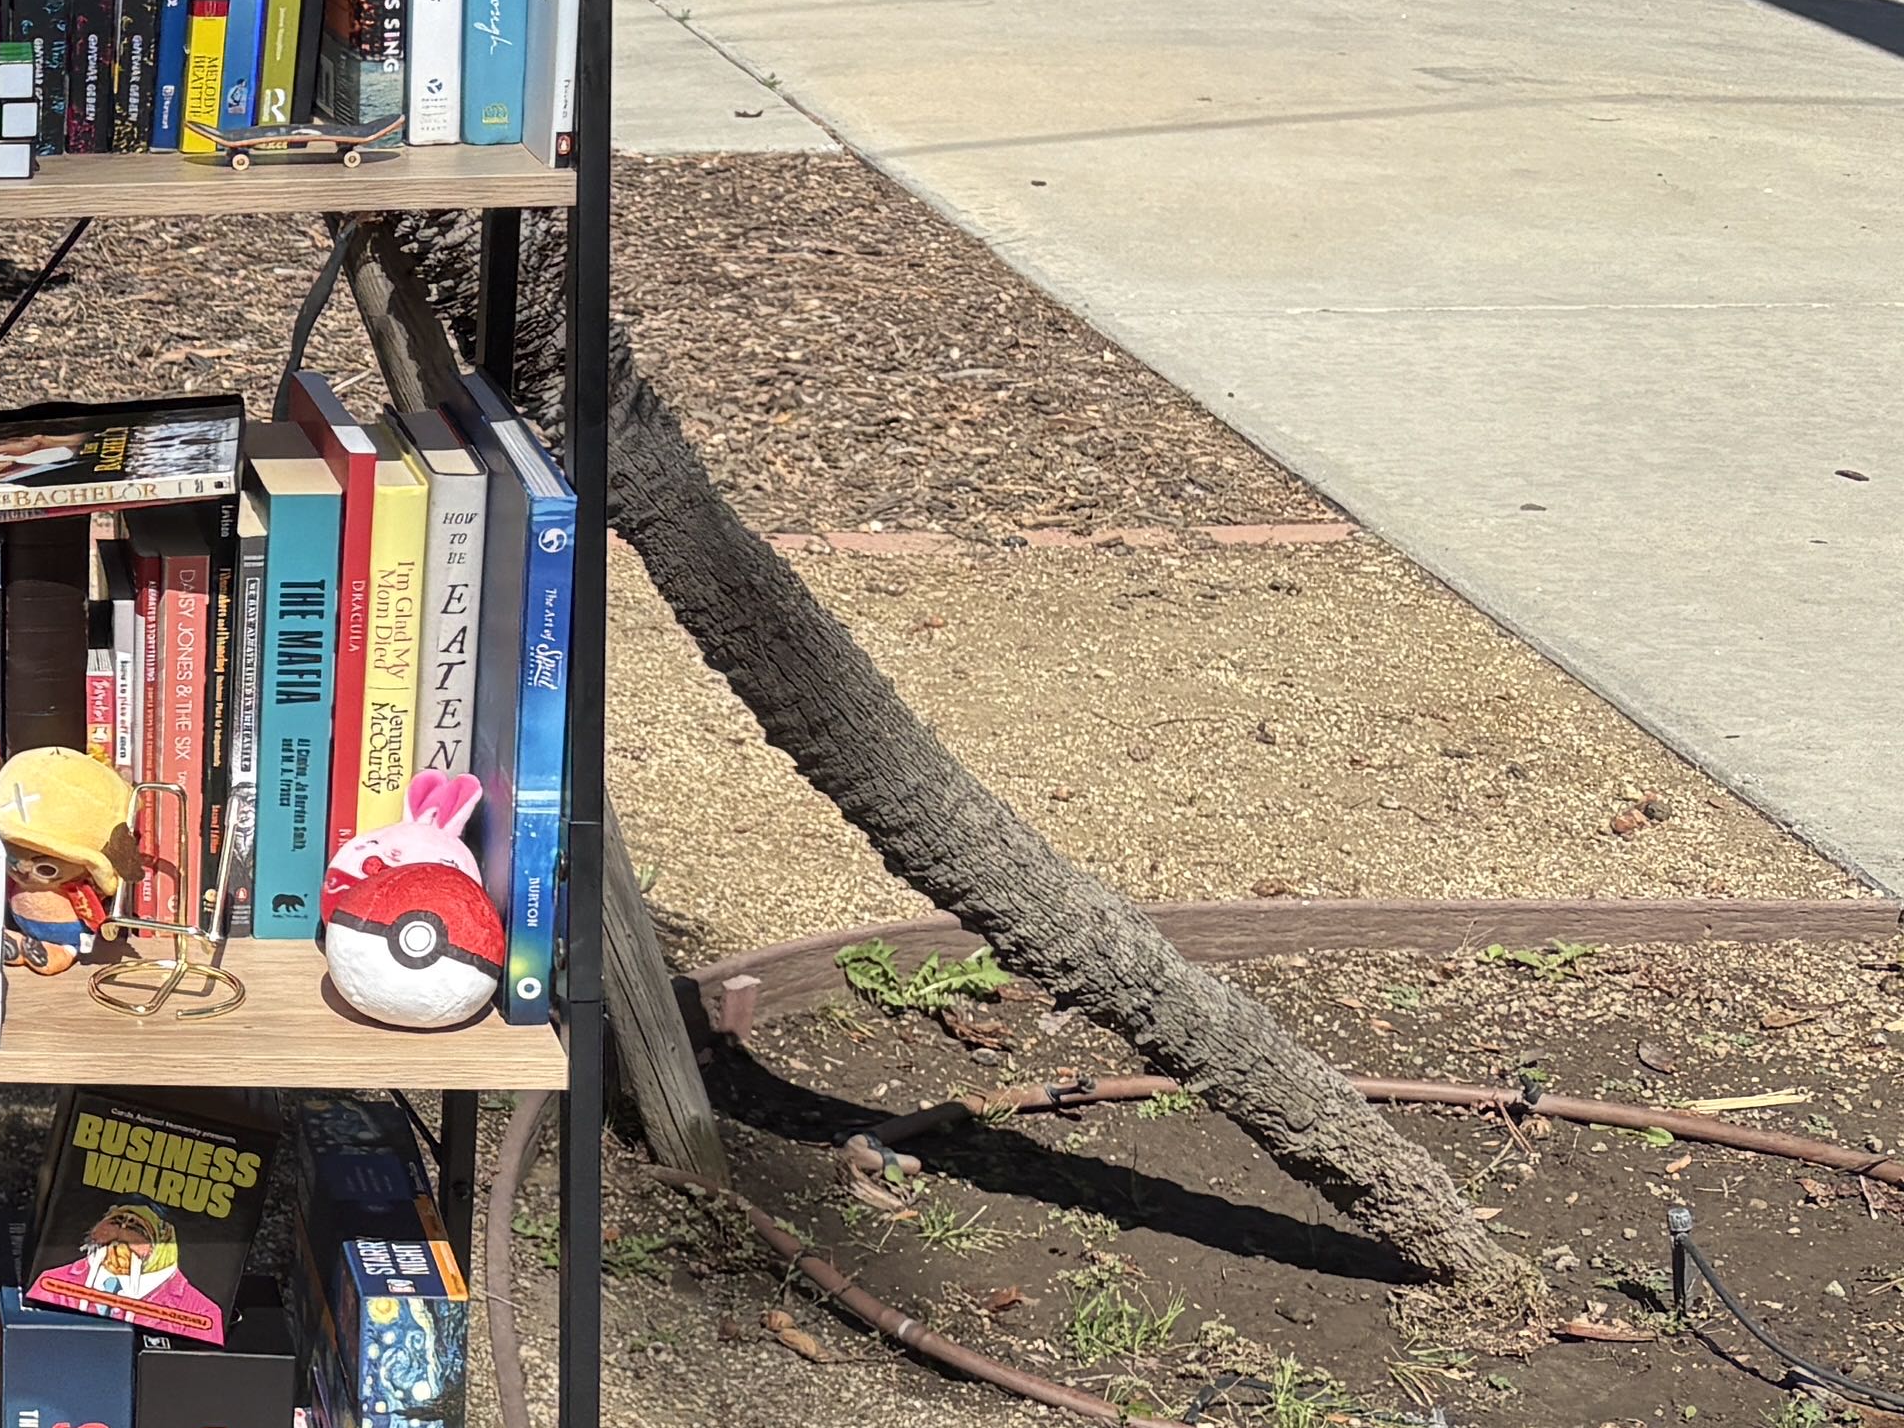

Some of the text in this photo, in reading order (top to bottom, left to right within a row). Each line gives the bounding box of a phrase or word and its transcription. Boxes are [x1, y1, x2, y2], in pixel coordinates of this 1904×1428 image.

[381, 17, 399, 74] SING
[203, 54, 221, 118] MELODY
[13, 483, 158, 512] BACHELOR
[443, 511, 478, 527] HOW
[448, 551, 467, 566] BE
[450, 532, 468, 546] TO
[178, 569, 196, 619] DAISY
[349, 580, 366, 652] DRACULA
[373, 569, 396, 670] Mom Died
[387, 561, 415, 680] I'm Glad My
[543, 609, 556, 627] Art
[176, 621, 195, 681] JONES
[275, 578, 326, 705] THE MAFIA
[177, 684, 191, 698] &
[423, 584, 469, 771] EATEN
[176, 700, 193, 730] THE
[175, 735, 192, 761] SIX
[362, 702, 390, 795] McCurdy
[386, 704, 408, 792] Jennette
[526, 877, 541, 927] BURTON
[72, 1112, 261, 1188] BUSINESS
[83, 1150, 236, 1219] WALRUS
[358, 1236, 431, 1276] STARRY NIGHT
